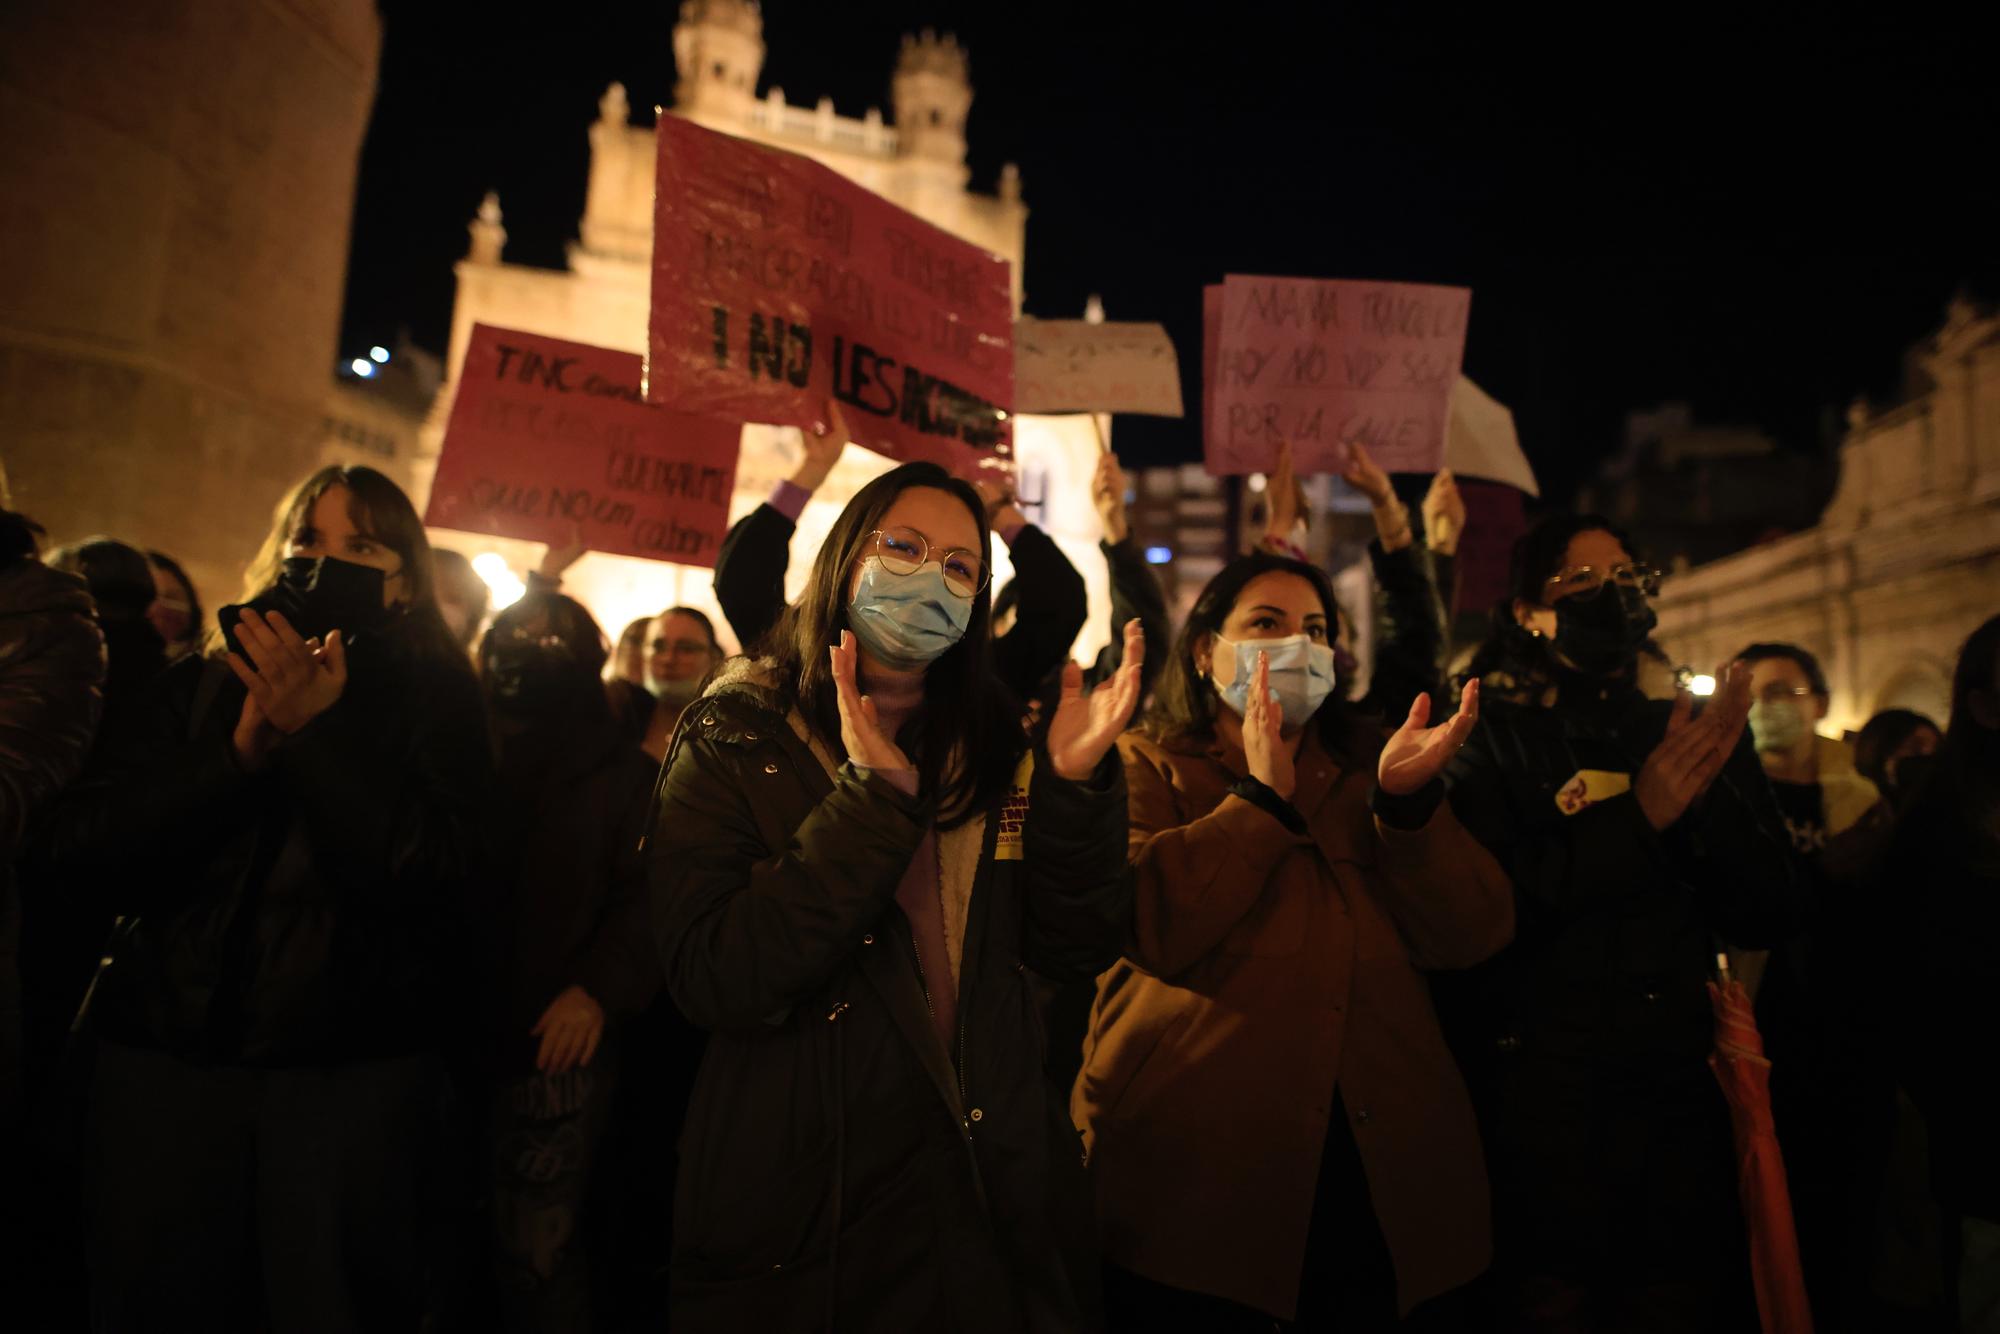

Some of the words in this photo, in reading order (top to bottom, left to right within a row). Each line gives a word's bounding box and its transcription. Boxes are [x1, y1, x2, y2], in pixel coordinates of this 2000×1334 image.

[494, 342, 580, 392] TINC
[748, 312, 813, 389] NO
[832, 335, 898, 418] LES
[1227, 400, 1284, 444] POR
[1293, 406, 1326, 442] LA
[546, 486, 591, 523] NO
